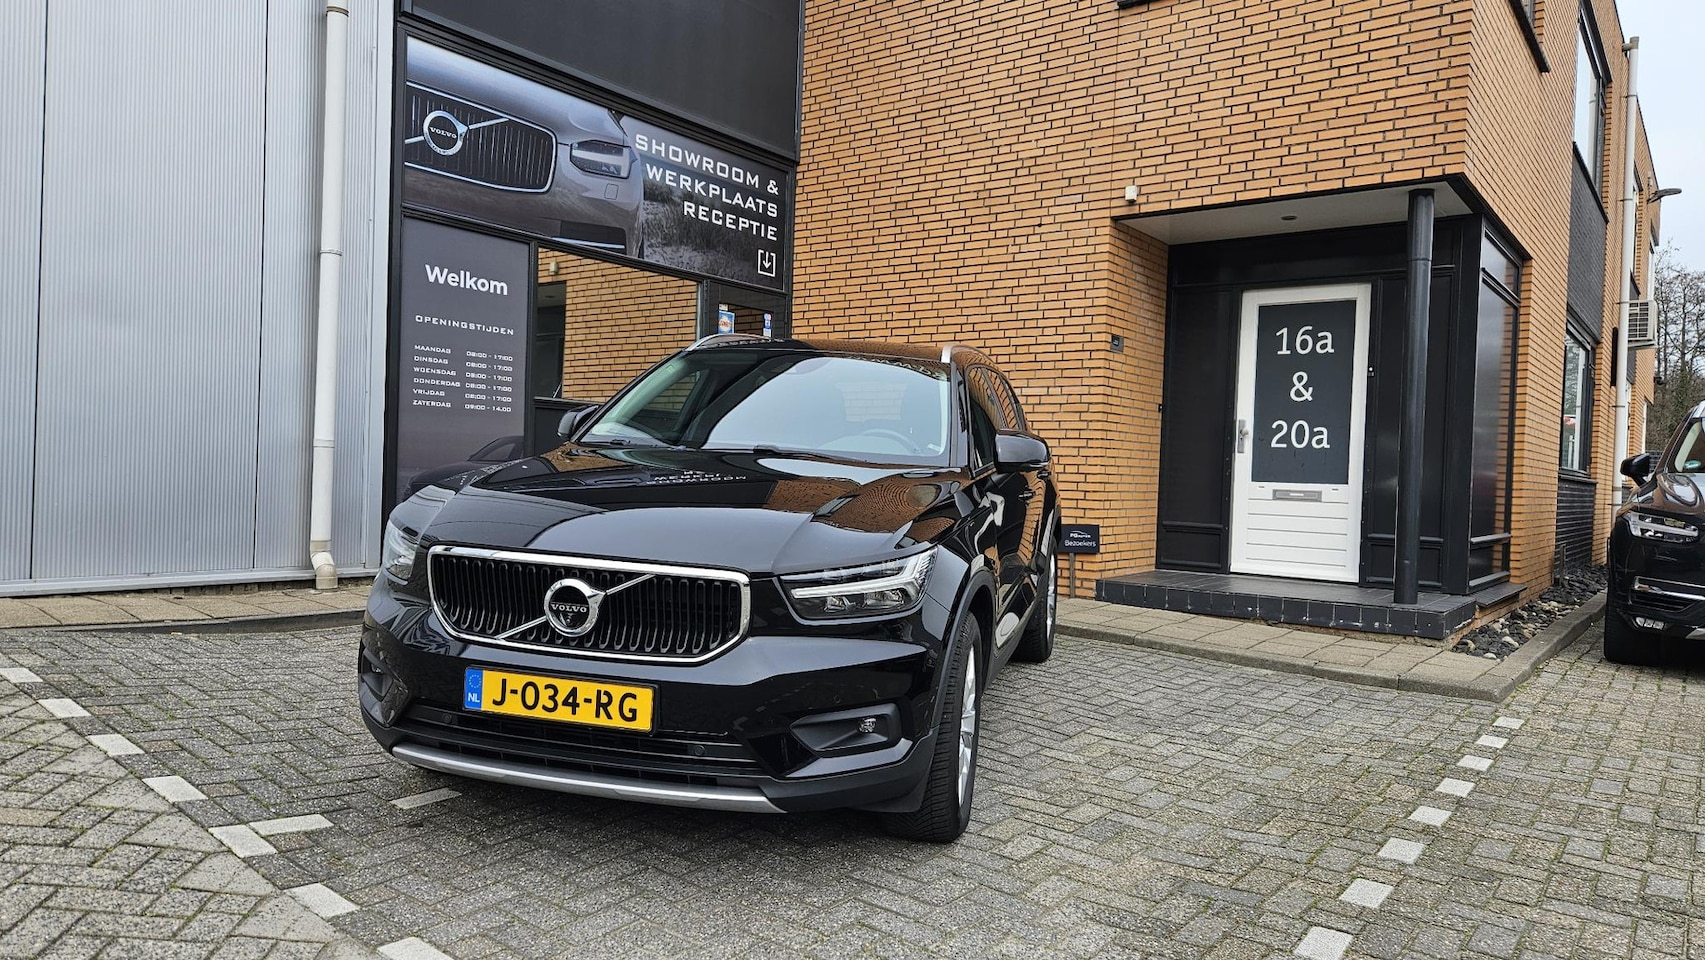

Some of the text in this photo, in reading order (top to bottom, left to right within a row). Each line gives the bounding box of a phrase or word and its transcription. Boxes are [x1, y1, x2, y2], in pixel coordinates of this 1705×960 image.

[429, 126, 457, 139] VOLVO
[635, 134, 779, 195] SHOWROOM &
[646, 163, 778, 217] WERKPLAATS
[683, 201, 778, 241] RECEPTIE
[424, 264, 508, 296] Welkom
[415, 314, 514, 335] OPENINGSTIJDEN
[1275, 325, 1335, 355] 16a
[414, 344, 451, 354] MAANDAG
[414, 356, 448, 364] DINSDAG
[413, 367, 456, 376] WOENSDAG
[413, 377, 460, 387] DONDERDAG
[1289, 371, 1313, 402] &
[412, 388, 445, 396] VRIJDAG
[413, 400, 451, 408] ZATERDAG
[1270, 419, 1331, 449] 20a
[1064, 539, 1097, 547] Bezoekers
[551, 602, 588, 613] VOLVO
[467, 678, 638, 723] NL J-034-RG
